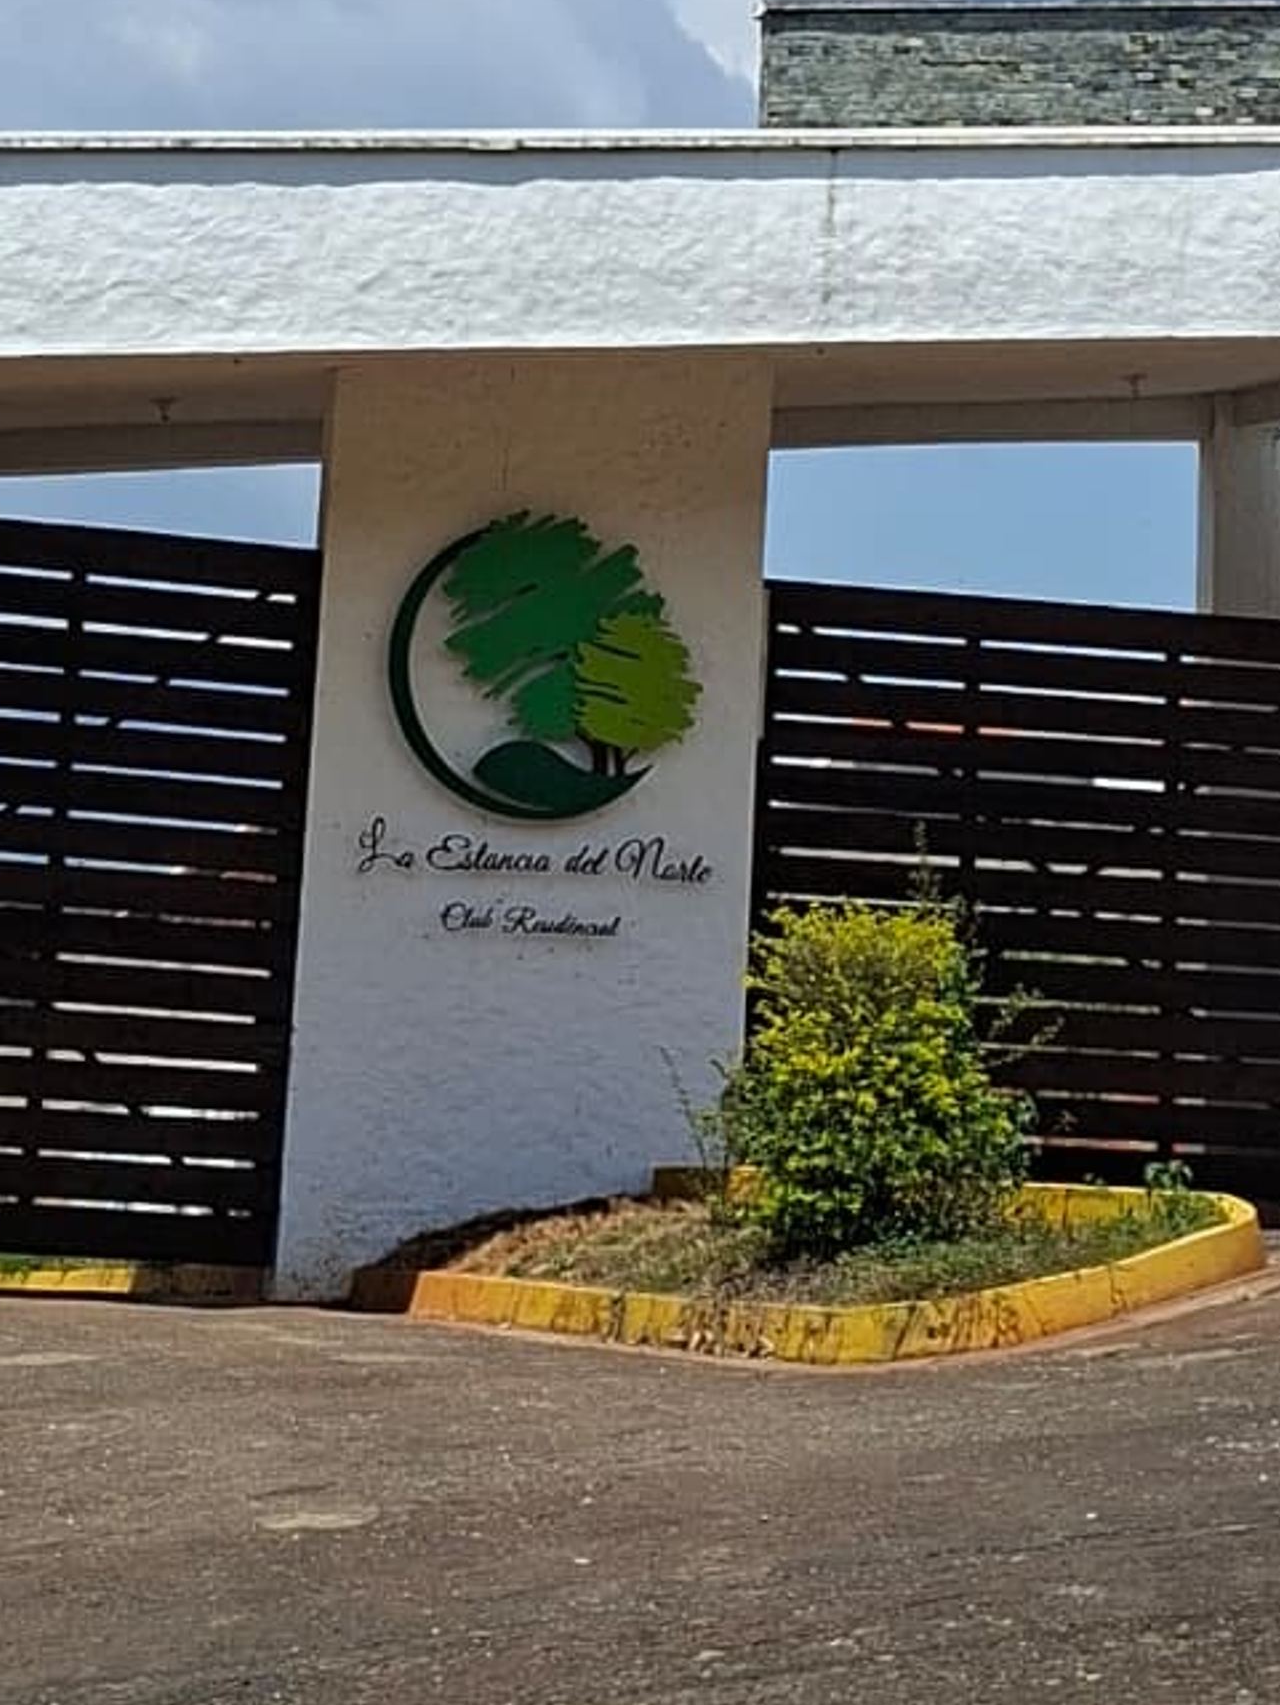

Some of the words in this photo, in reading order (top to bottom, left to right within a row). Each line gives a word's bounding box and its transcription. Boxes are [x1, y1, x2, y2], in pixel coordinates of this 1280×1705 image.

[357, 816, 415, 874] La
[425, 833, 551, 873] Estancia
[564, 845, 608, 877] del
[614, 836, 714, 885] Norte
[440, 901, 493, 932] Club
